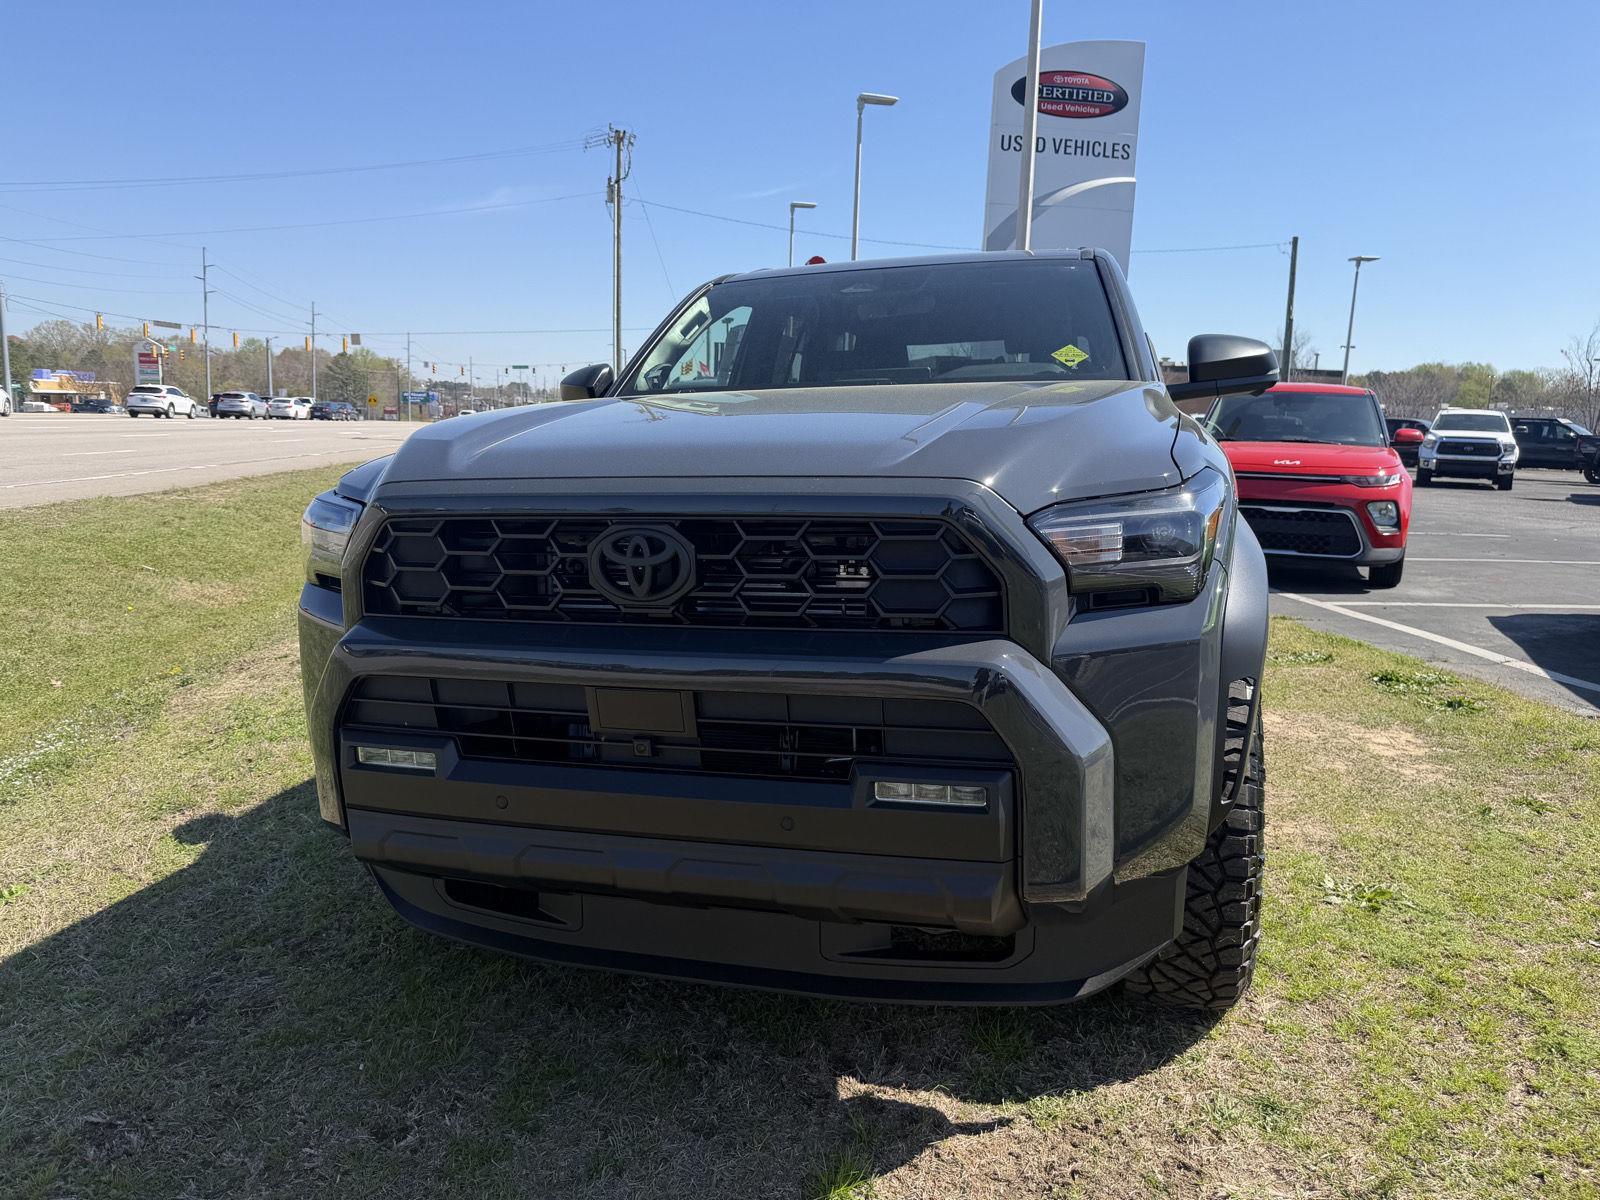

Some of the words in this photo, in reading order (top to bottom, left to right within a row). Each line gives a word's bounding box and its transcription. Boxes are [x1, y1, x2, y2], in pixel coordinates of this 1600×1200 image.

[1064, 77, 1089, 85] TOYOTA
[1040, 103, 1063, 111] Used
[1065, 104, 1100, 113] Vehicles
[1001, 134, 1046, 153] USD
[1052, 137, 1131, 160] VEHICLES
